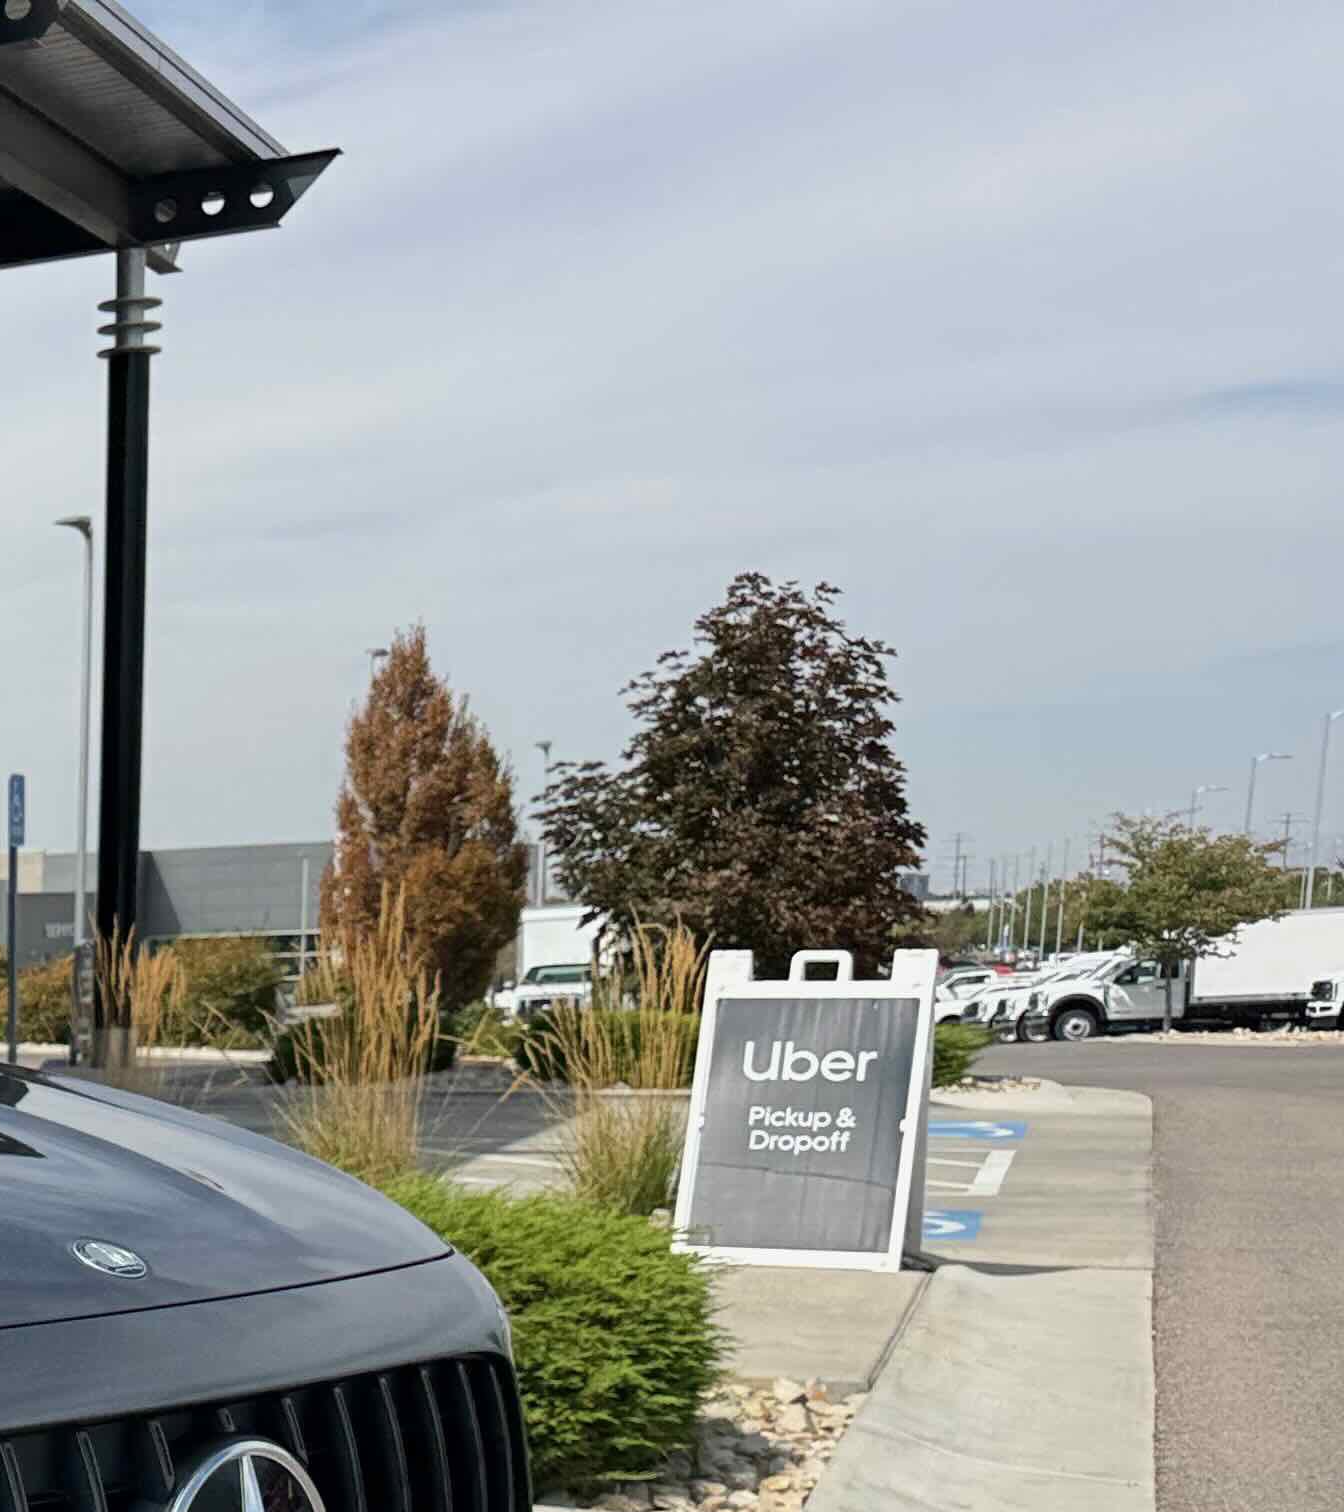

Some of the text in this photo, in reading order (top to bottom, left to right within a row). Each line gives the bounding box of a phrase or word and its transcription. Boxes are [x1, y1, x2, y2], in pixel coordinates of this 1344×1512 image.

[742, 1040, 879, 1082] Uber
[747, 1106, 857, 1132] Pickup &
[748, 1130, 852, 1156] Dropoff
